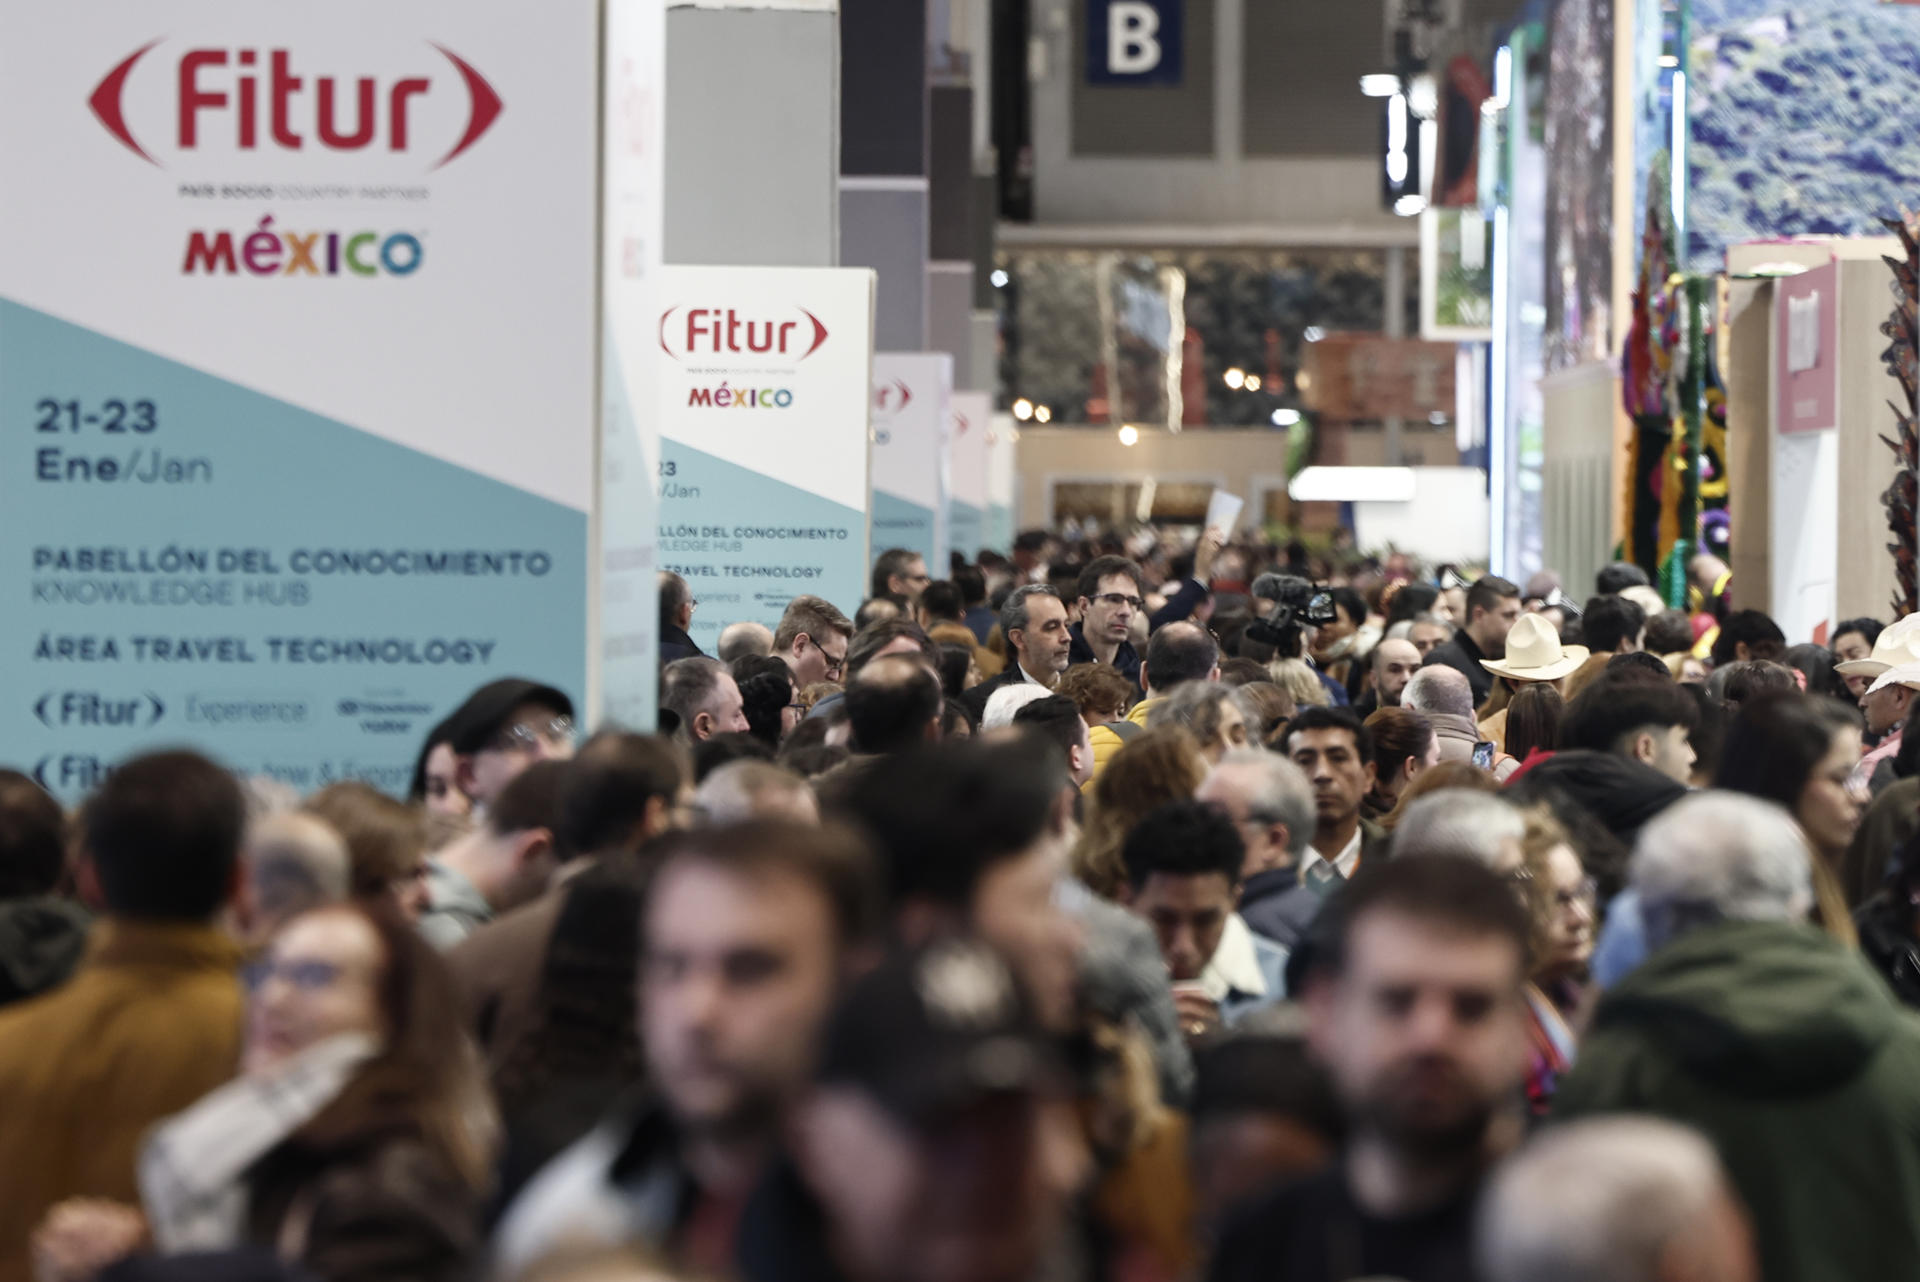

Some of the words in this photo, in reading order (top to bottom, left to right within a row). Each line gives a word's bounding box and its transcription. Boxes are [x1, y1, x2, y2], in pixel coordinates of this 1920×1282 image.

[1107, 0, 1163, 74] B
[177, 50, 431, 150] Fitur
[687, 308, 797, 353] Fitur
[35, 398, 158, 434] 21-23
[35, 447, 213, 484] Ene/Jan
[702, 526, 729, 538] DEL
[733, 527, 848, 541] CONOCIMIENTO
[34, 546, 208, 575] PABELLÓN
[217, 549, 280, 575] DEL
[289, 550, 552, 577] CONOCIMIENTO
[724, 565, 823, 579] TECHNOLOGY
[34, 580, 234, 605] KNOWLEDGE
[242, 582, 310, 606] HUB
[34, 632, 121, 662] ÁREA
[132, 638, 256, 663] TRAVEL
[266, 638, 496, 665] TECHNOLOGY
[61, 693, 141, 726] Fitur
